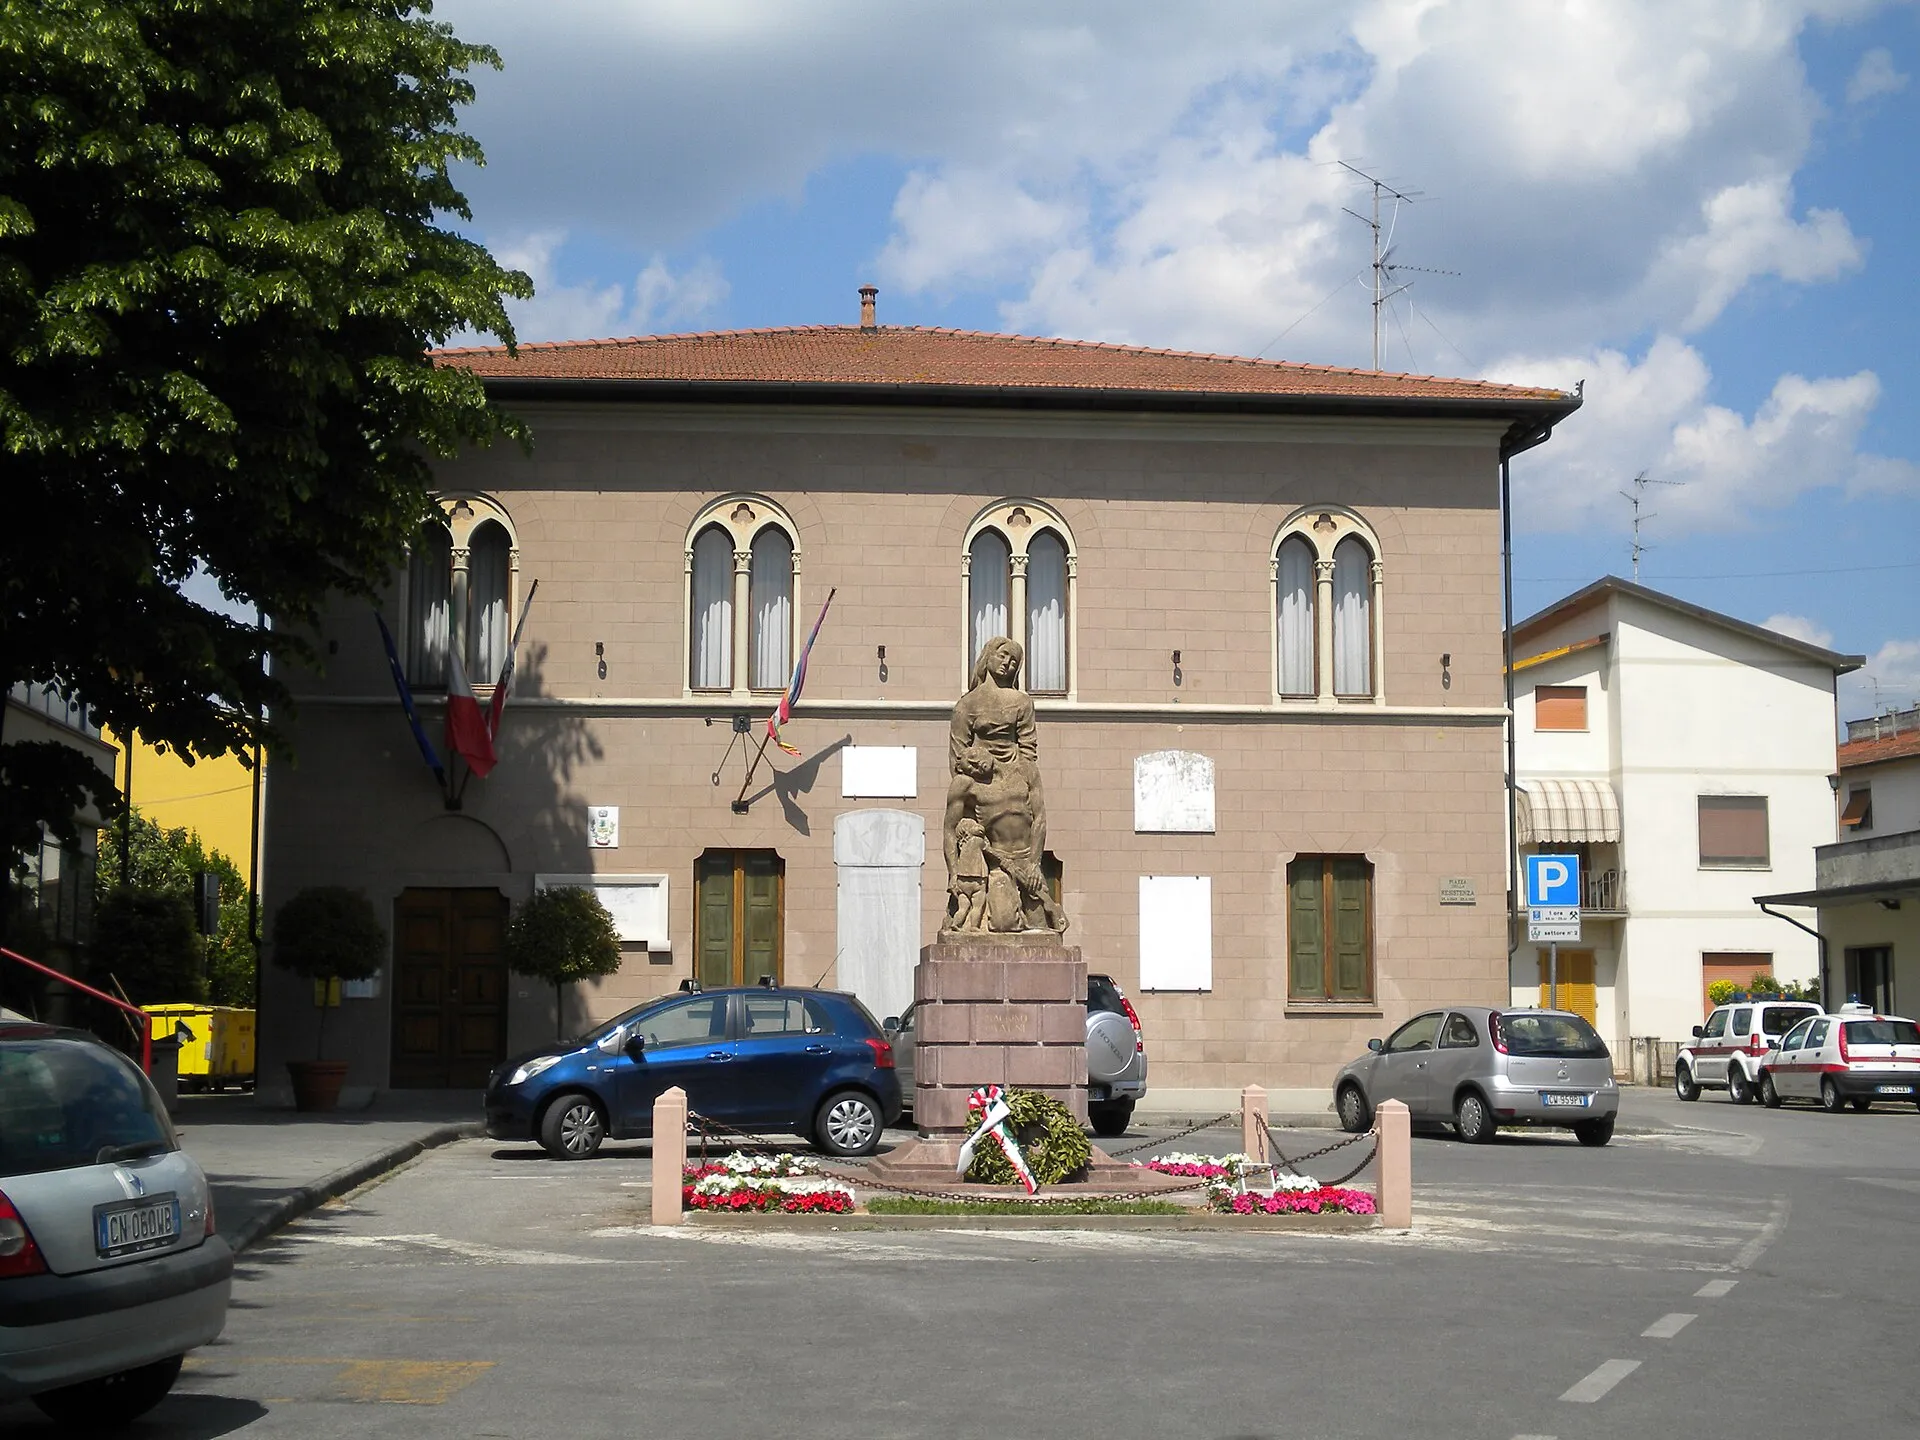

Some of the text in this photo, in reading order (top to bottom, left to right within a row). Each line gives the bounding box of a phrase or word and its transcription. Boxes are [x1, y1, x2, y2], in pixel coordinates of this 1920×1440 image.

[1537, 861, 1569, 901] P
[1097, 1028, 1124, 1062] HONDA
[109, 1206, 172, 1244] CN 060WB
